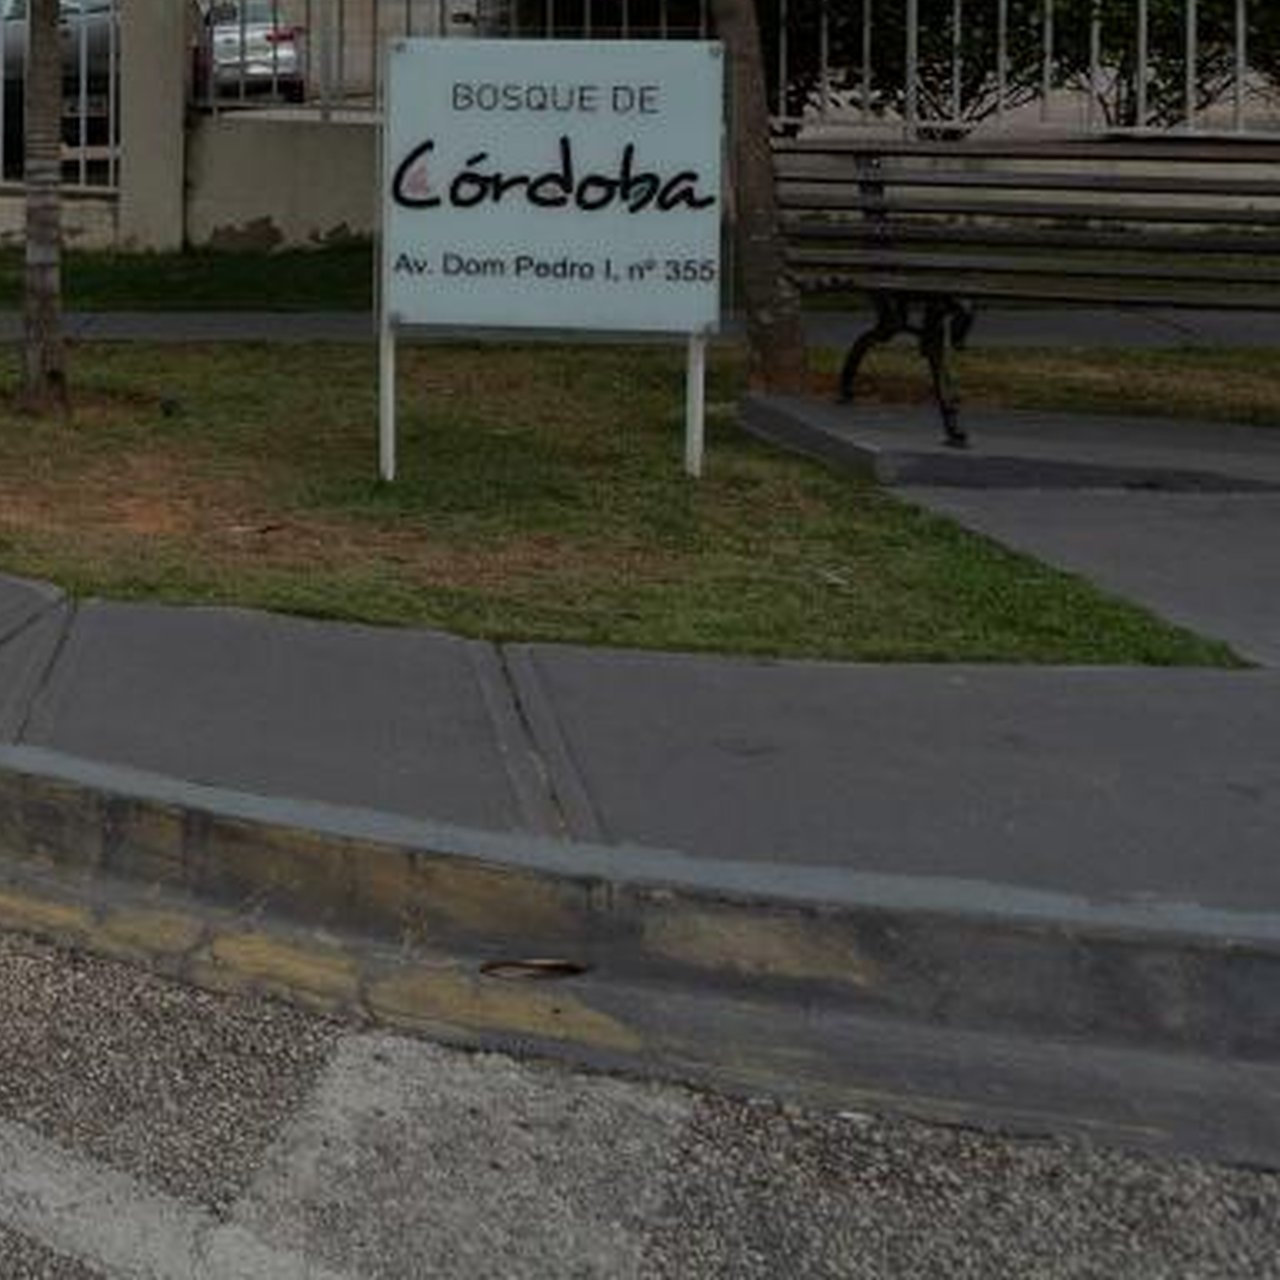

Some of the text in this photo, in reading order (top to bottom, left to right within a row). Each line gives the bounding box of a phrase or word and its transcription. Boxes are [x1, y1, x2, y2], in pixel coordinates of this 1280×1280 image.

[452, 83, 661, 114] BOSQUE DE
[392, 136, 715, 214] Córdoba
[394, 253, 433, 275] Av.
[442, 253, 504, 277] Dom
[515, 254, 593, 280] Pedro
[665, 260, 715, 282] 355
